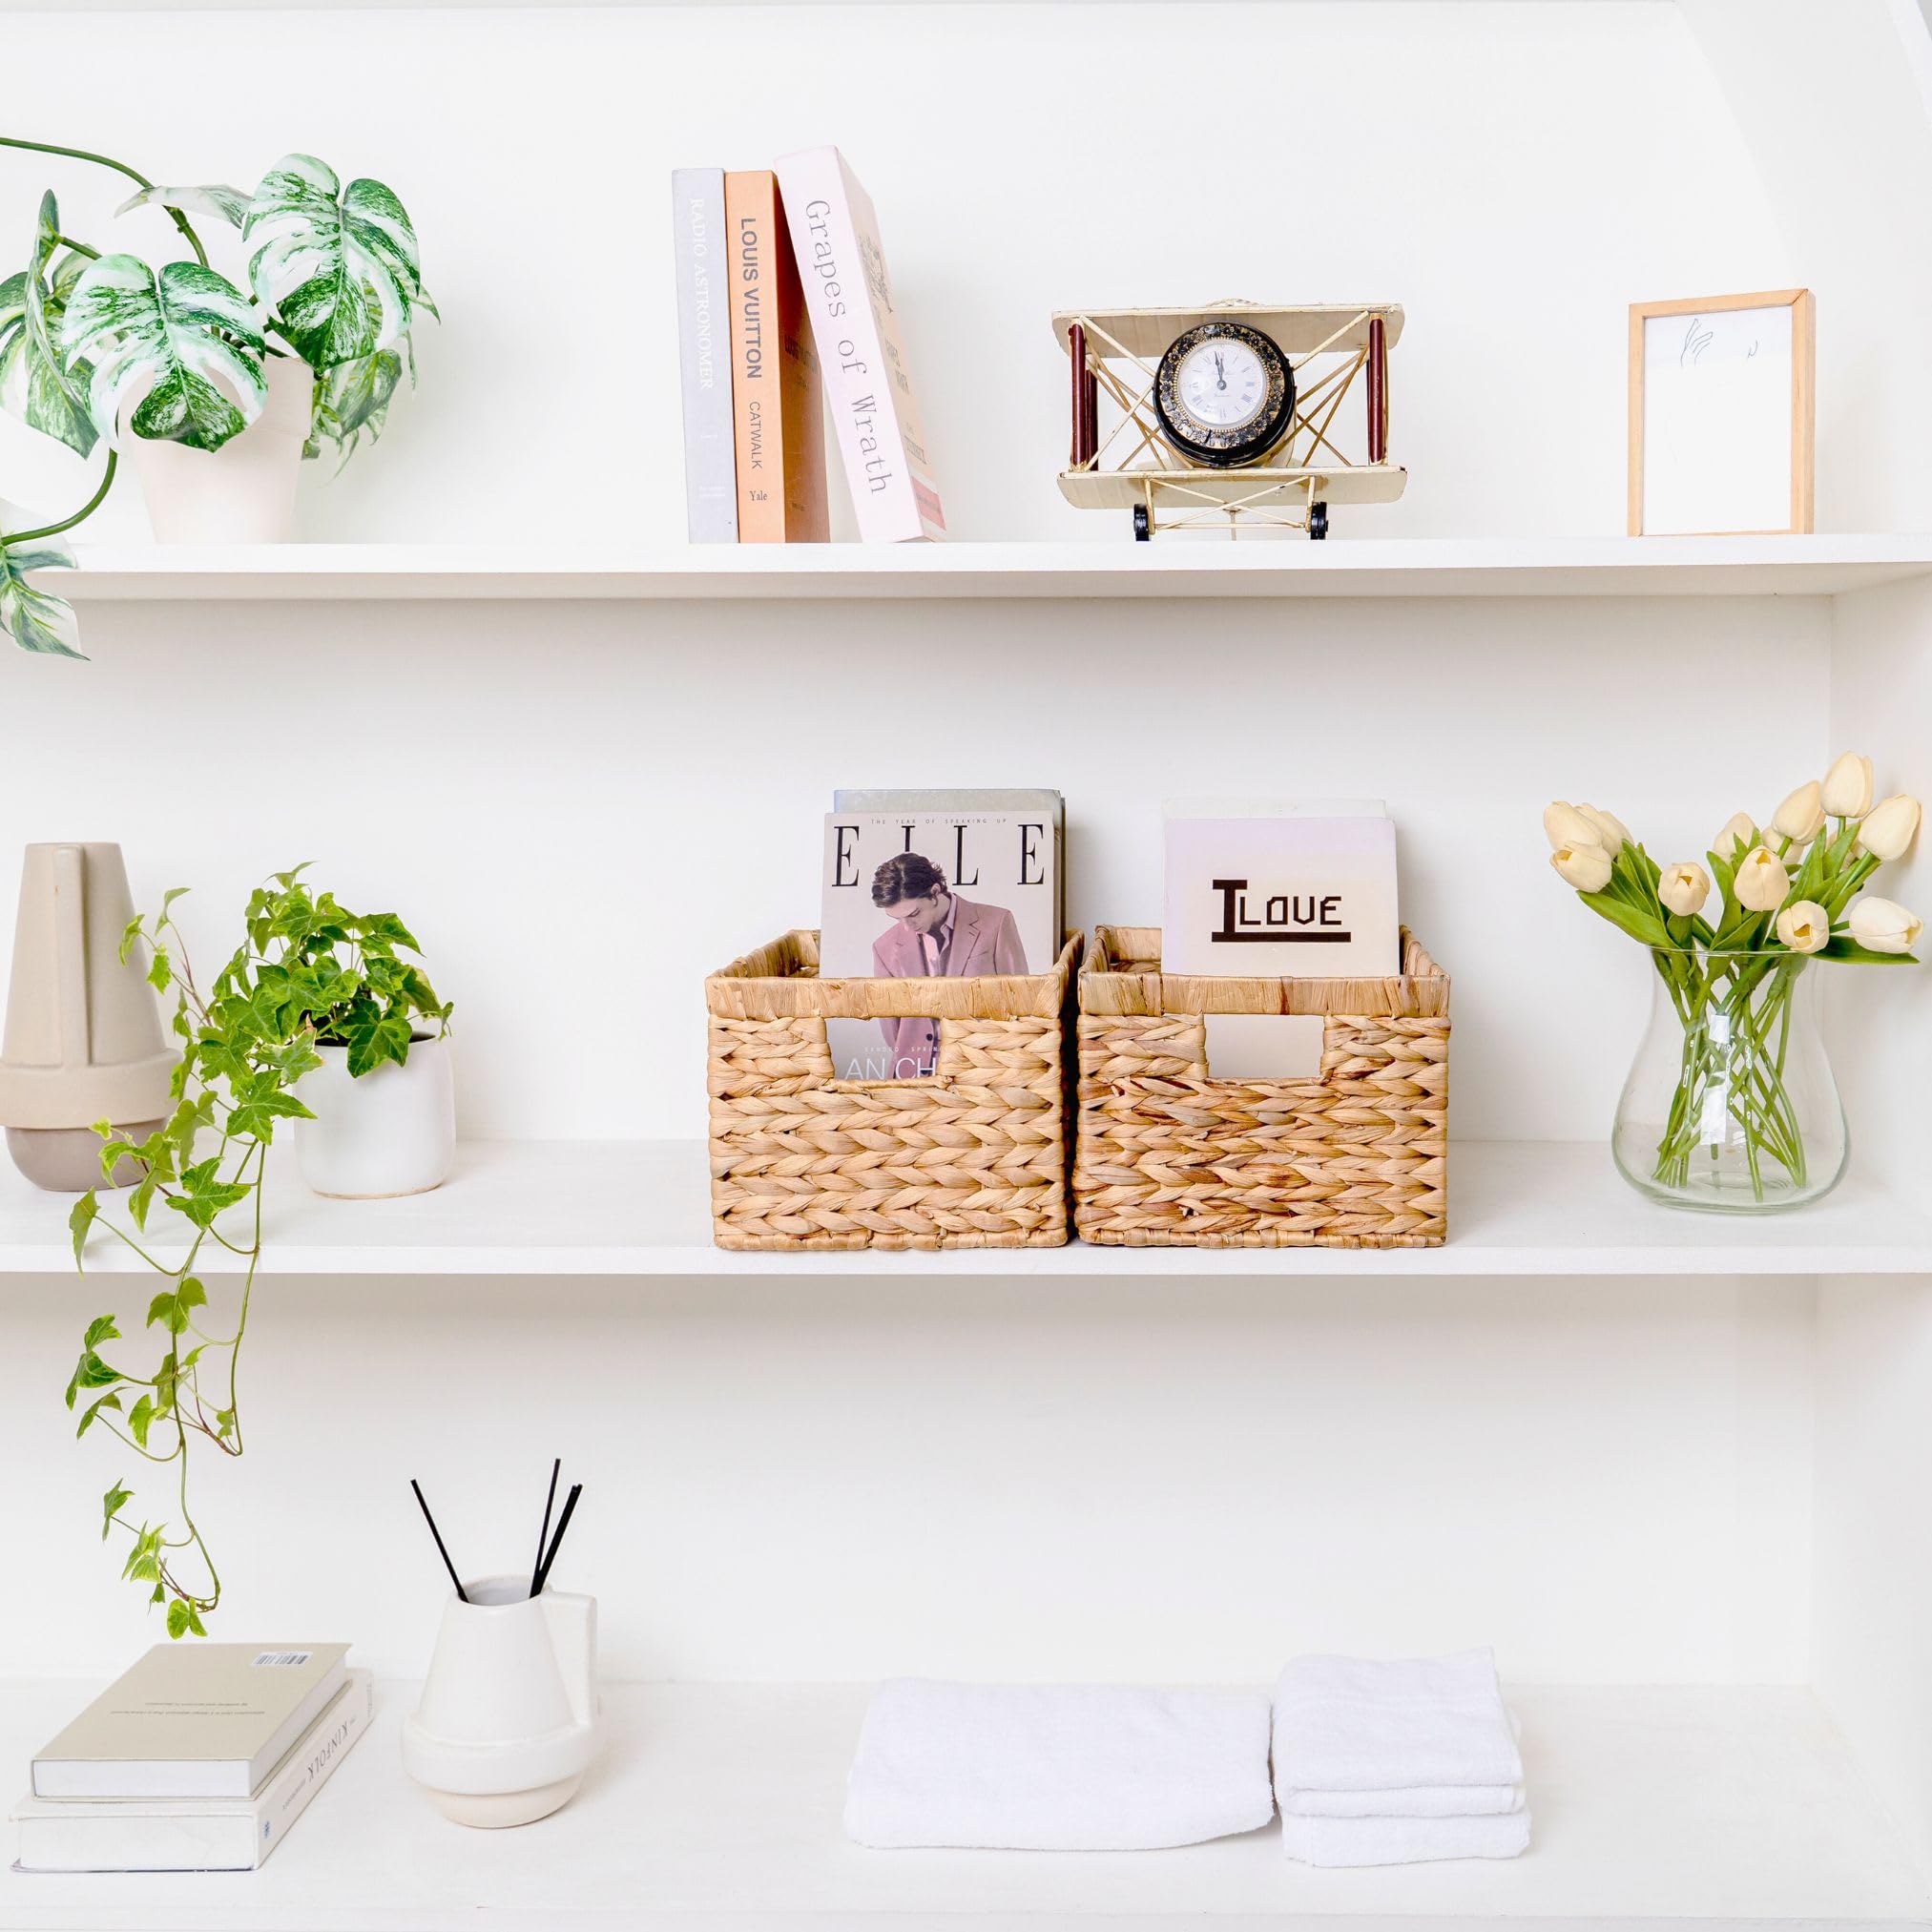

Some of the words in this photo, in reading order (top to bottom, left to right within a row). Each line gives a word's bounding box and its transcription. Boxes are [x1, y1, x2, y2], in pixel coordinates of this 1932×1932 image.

[691, 198, 707, 257] RADIO
[740, 218, 759, 281] LOUIS
[805, 199, 846, 318] Grapes
[694, 263, 714, 389] ASTRONOMER
[743, 287, 762, 379] VUITTON
[838, 340, 867, 374] of
[749, 401, 763, 469] CATWALK
[851, 394, 892, 493] Wrath
[749, 489, 769, 502] Yale
[844, 1057, 885, 1080] AN
[306, 1720, 349, 1783] KINFOLK
